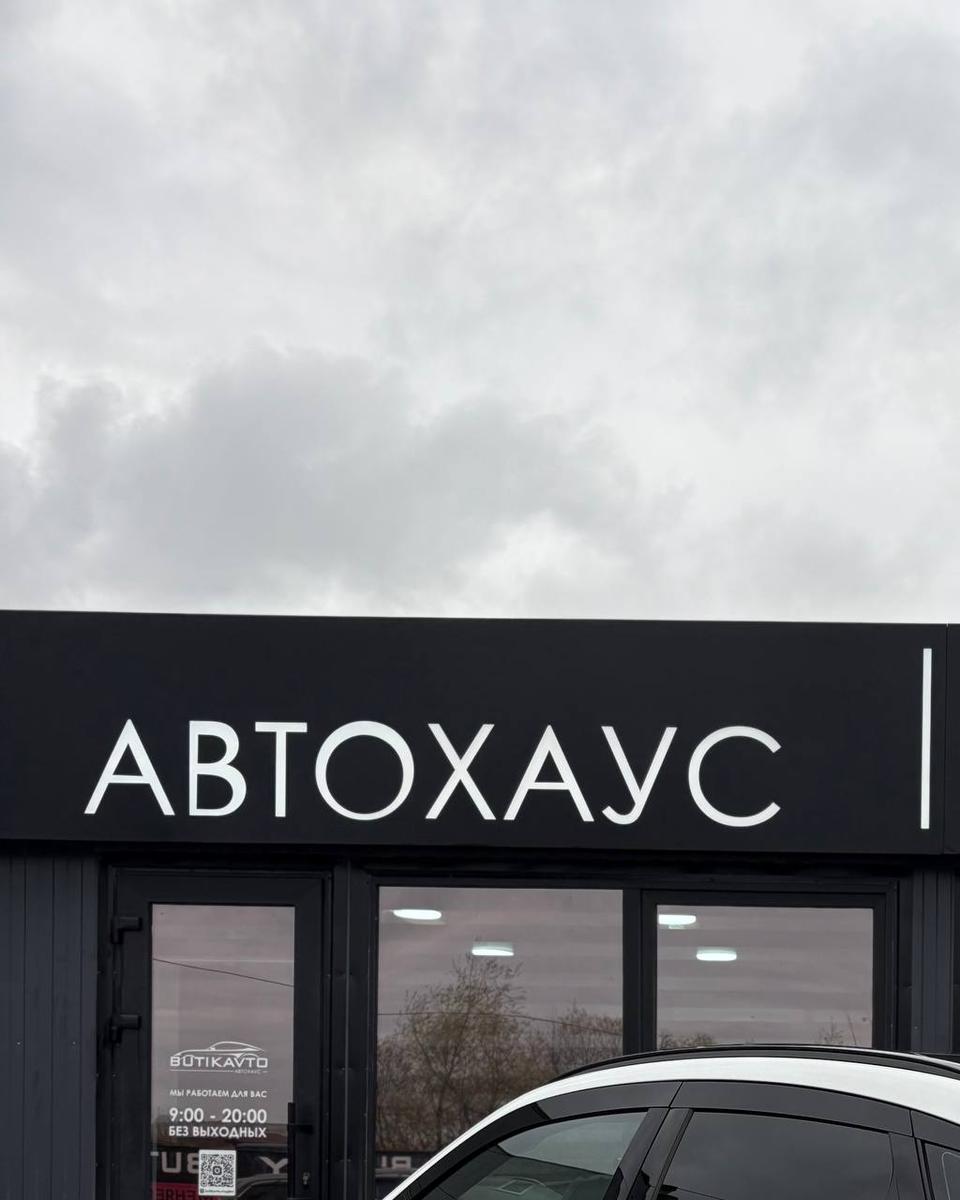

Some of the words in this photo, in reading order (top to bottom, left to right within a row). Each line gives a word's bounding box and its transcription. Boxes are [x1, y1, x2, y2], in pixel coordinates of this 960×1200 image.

[84, 718, 782, 827] АВТОХАУС
[169, 1056, 268, 1068] BUTIKAVTO
[169, 1089, 184, 1097] МЫ
[186, 1089, 229, 1098] РАБОТАЕМ
[230, 1090, 248, 1098] ДЛЯ
[250, 1090, 268, 1098] ВАС
[168, 1107, 204, 1122] 9:00
[221, 1108, 268, 1123] 20:00
[168, 1125, 189, 1137] БЕЗ
[192, 1126, 267, 1139] ВЫХОДНЫХ
